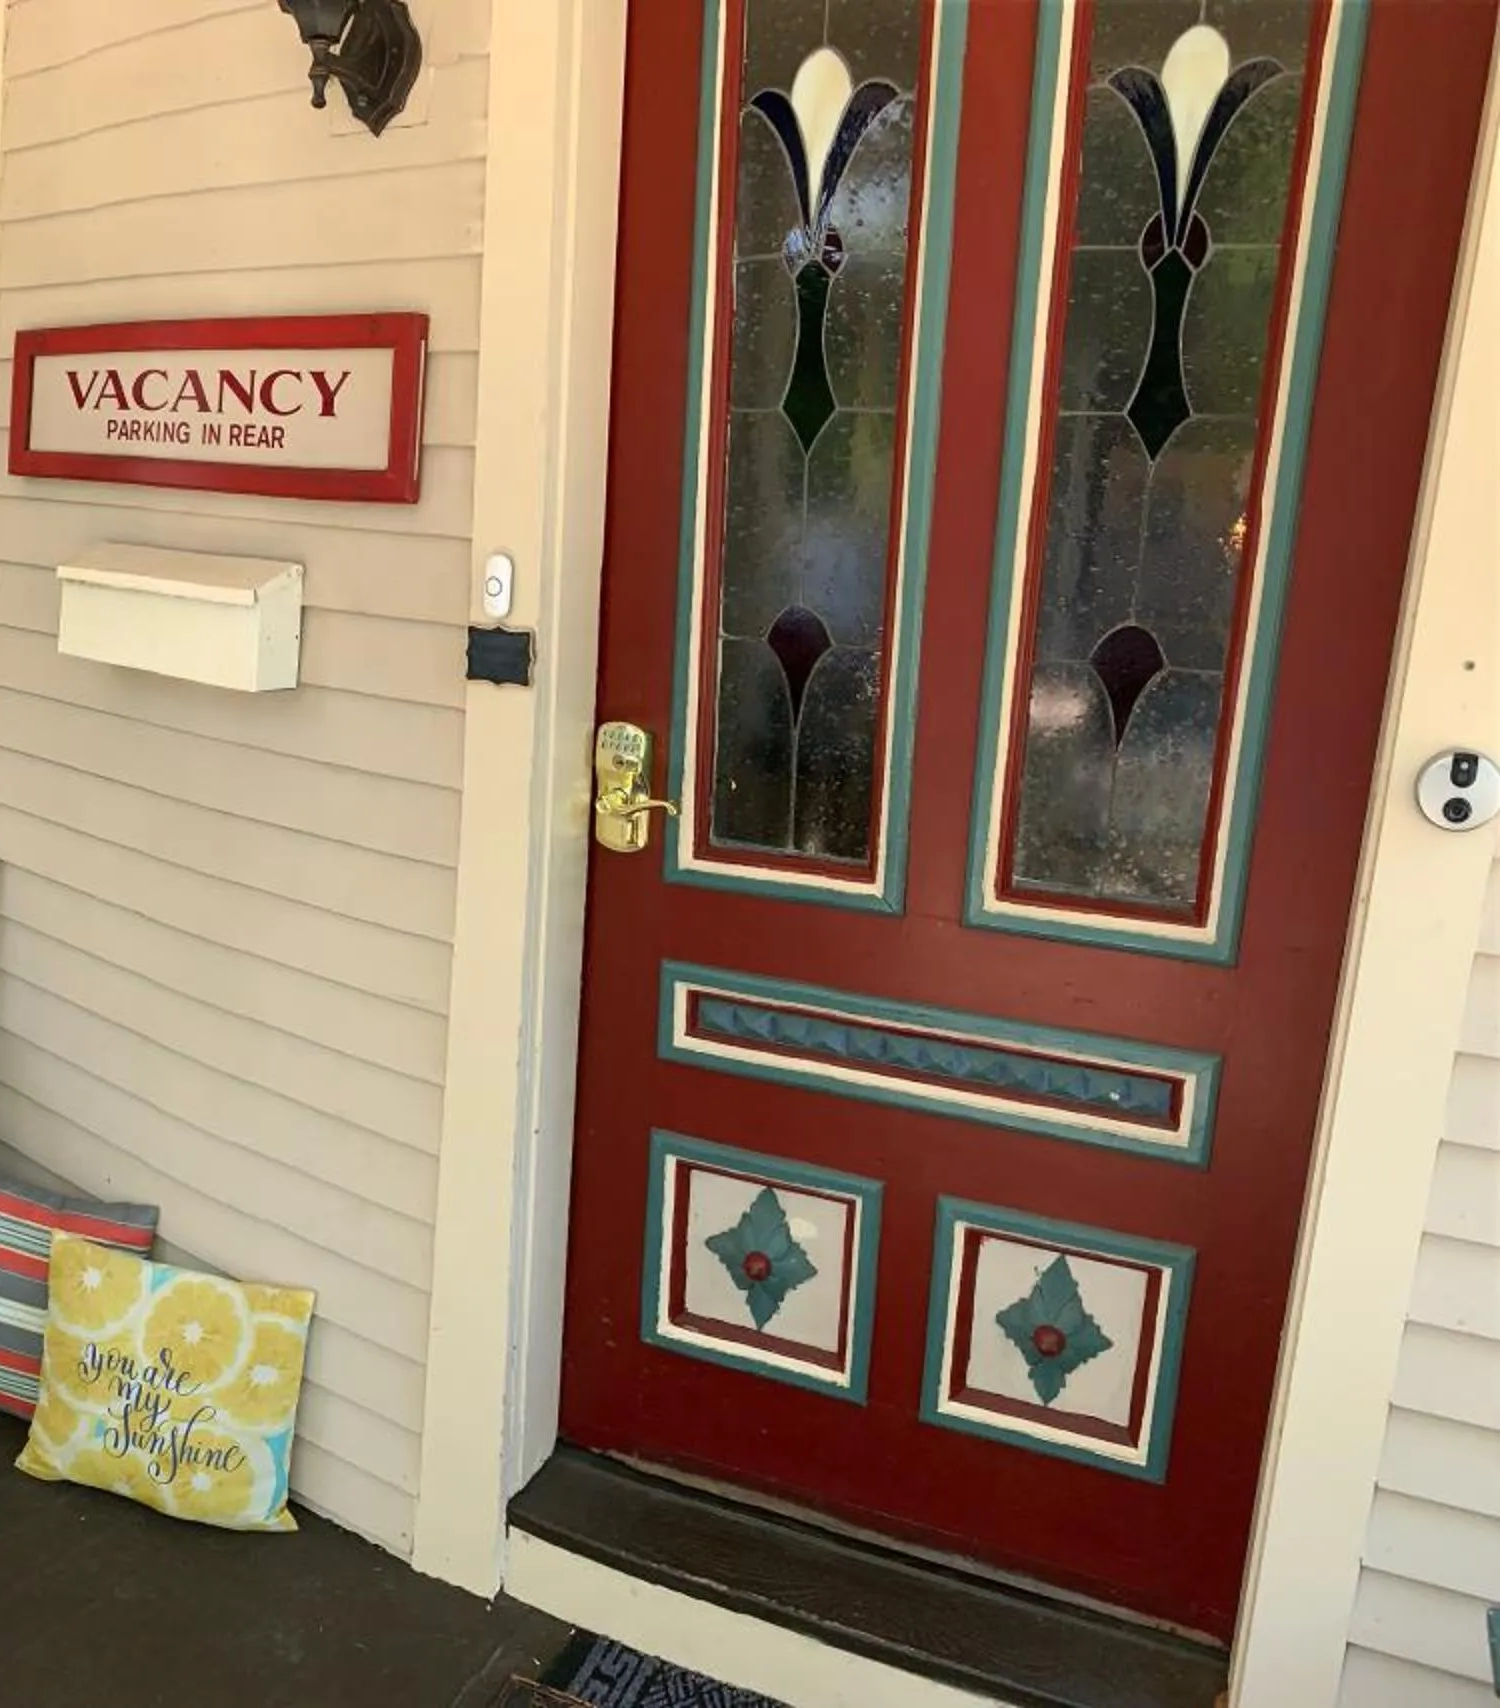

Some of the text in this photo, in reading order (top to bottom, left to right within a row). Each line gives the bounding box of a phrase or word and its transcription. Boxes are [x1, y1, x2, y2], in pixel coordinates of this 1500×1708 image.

[67, 369, 351, 417] VACANCY
[107, 419, 285, 449] PARKING IN REAR
[143, 1347, 200, 1396] are
[109, 1375, 171, 1431] my
